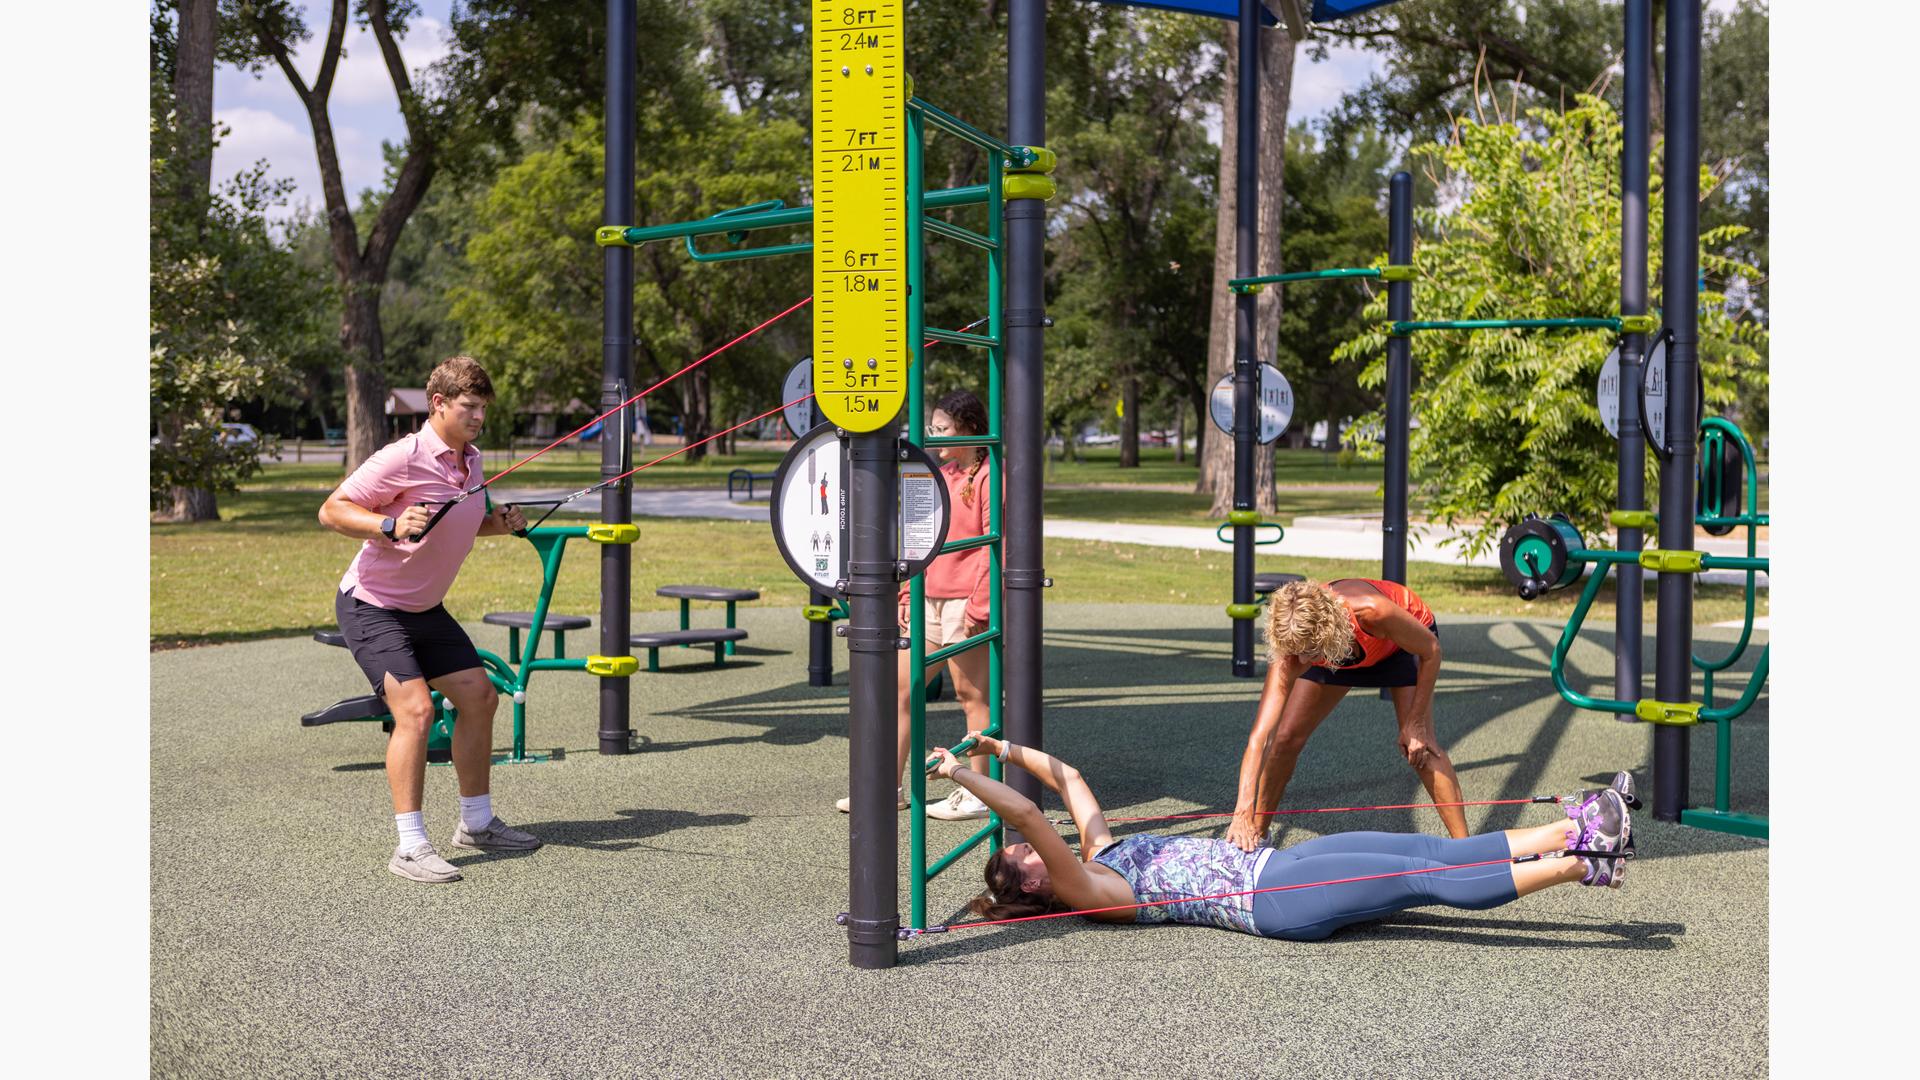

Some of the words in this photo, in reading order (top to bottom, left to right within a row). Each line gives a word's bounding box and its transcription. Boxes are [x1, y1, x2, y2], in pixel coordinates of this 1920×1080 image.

[843, 7, 855, 25] 8
[845, 129, 856, 146] 7
[859, 132, 878, 145] FT
[844, 250, 856, 267] 6
[860, 253, 879, 266] FT
[845, 370, 856, 388] 5
[861, 374, 880, 387] FT
